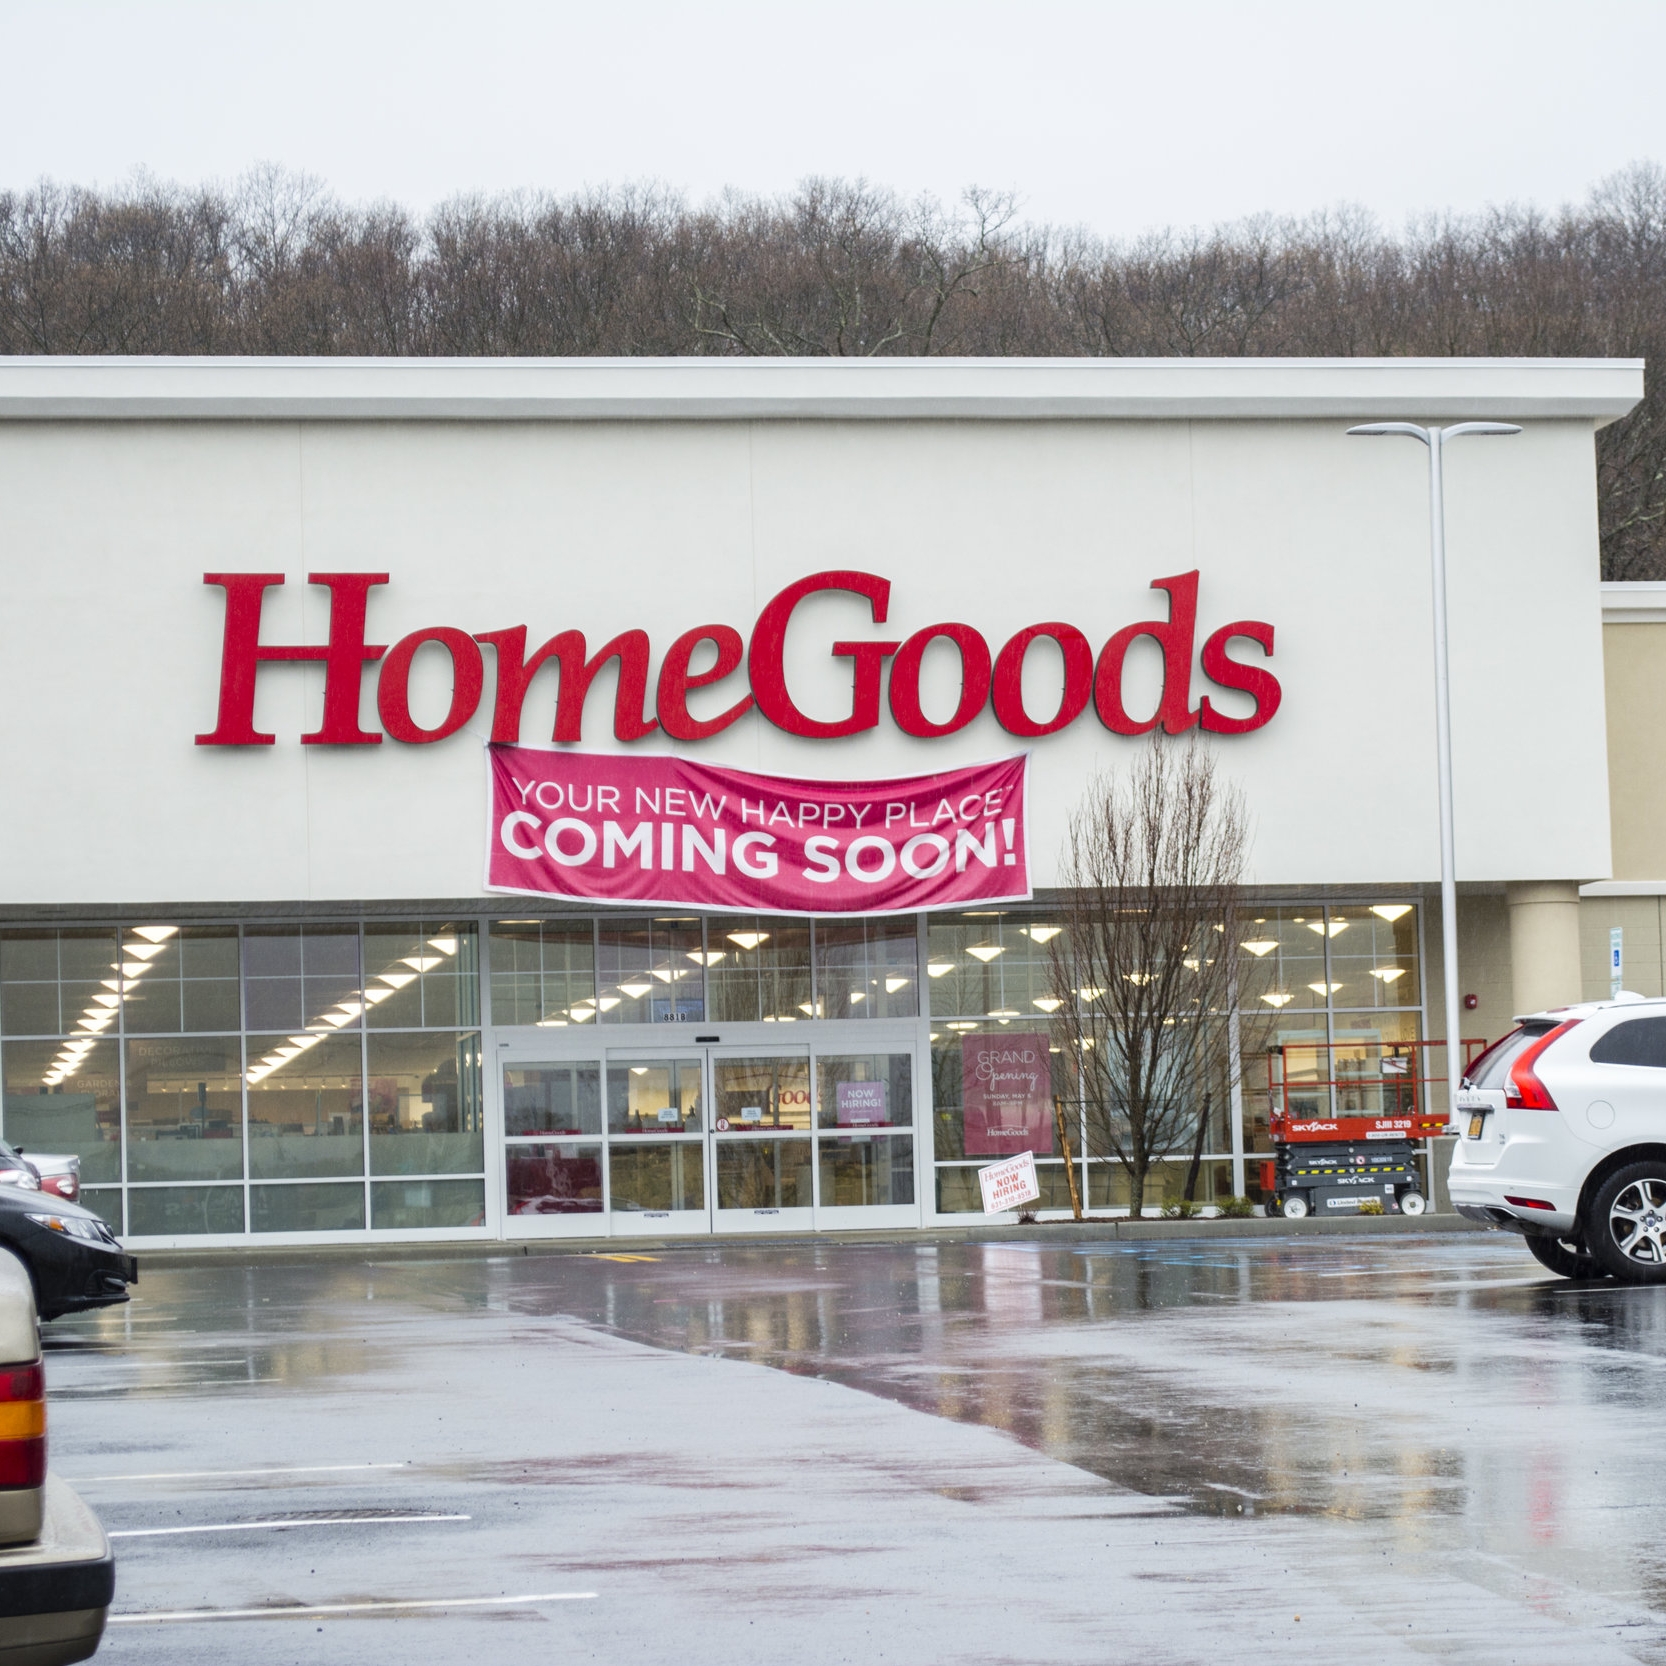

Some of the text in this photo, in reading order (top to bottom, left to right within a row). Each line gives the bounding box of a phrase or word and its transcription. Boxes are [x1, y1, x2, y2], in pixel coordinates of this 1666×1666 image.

[194, 568, 1282, 746] HomeGoods
[512, 776, 620, 813] YOUR
[635, 787, 727, 820] NEW
[741, 798, 871, 829] HAPPY
[501, 810, 1017, 882] COMING SOON!
[978, 1050, 1035, 1064] GRAND
[975, 1062, 1039, 1091] Opening
[848, 1089, 874, 1099] NOW
[841, 1099, 881, 1109] HIRING!
[986, 1128, 1029, 1137] HomeGoods
[1291, 1121, 1338, 1132] SKYJACK
[996, 1172, 1019, 1188] NOW
[992, 1180, 1027, 1200] HIRING
